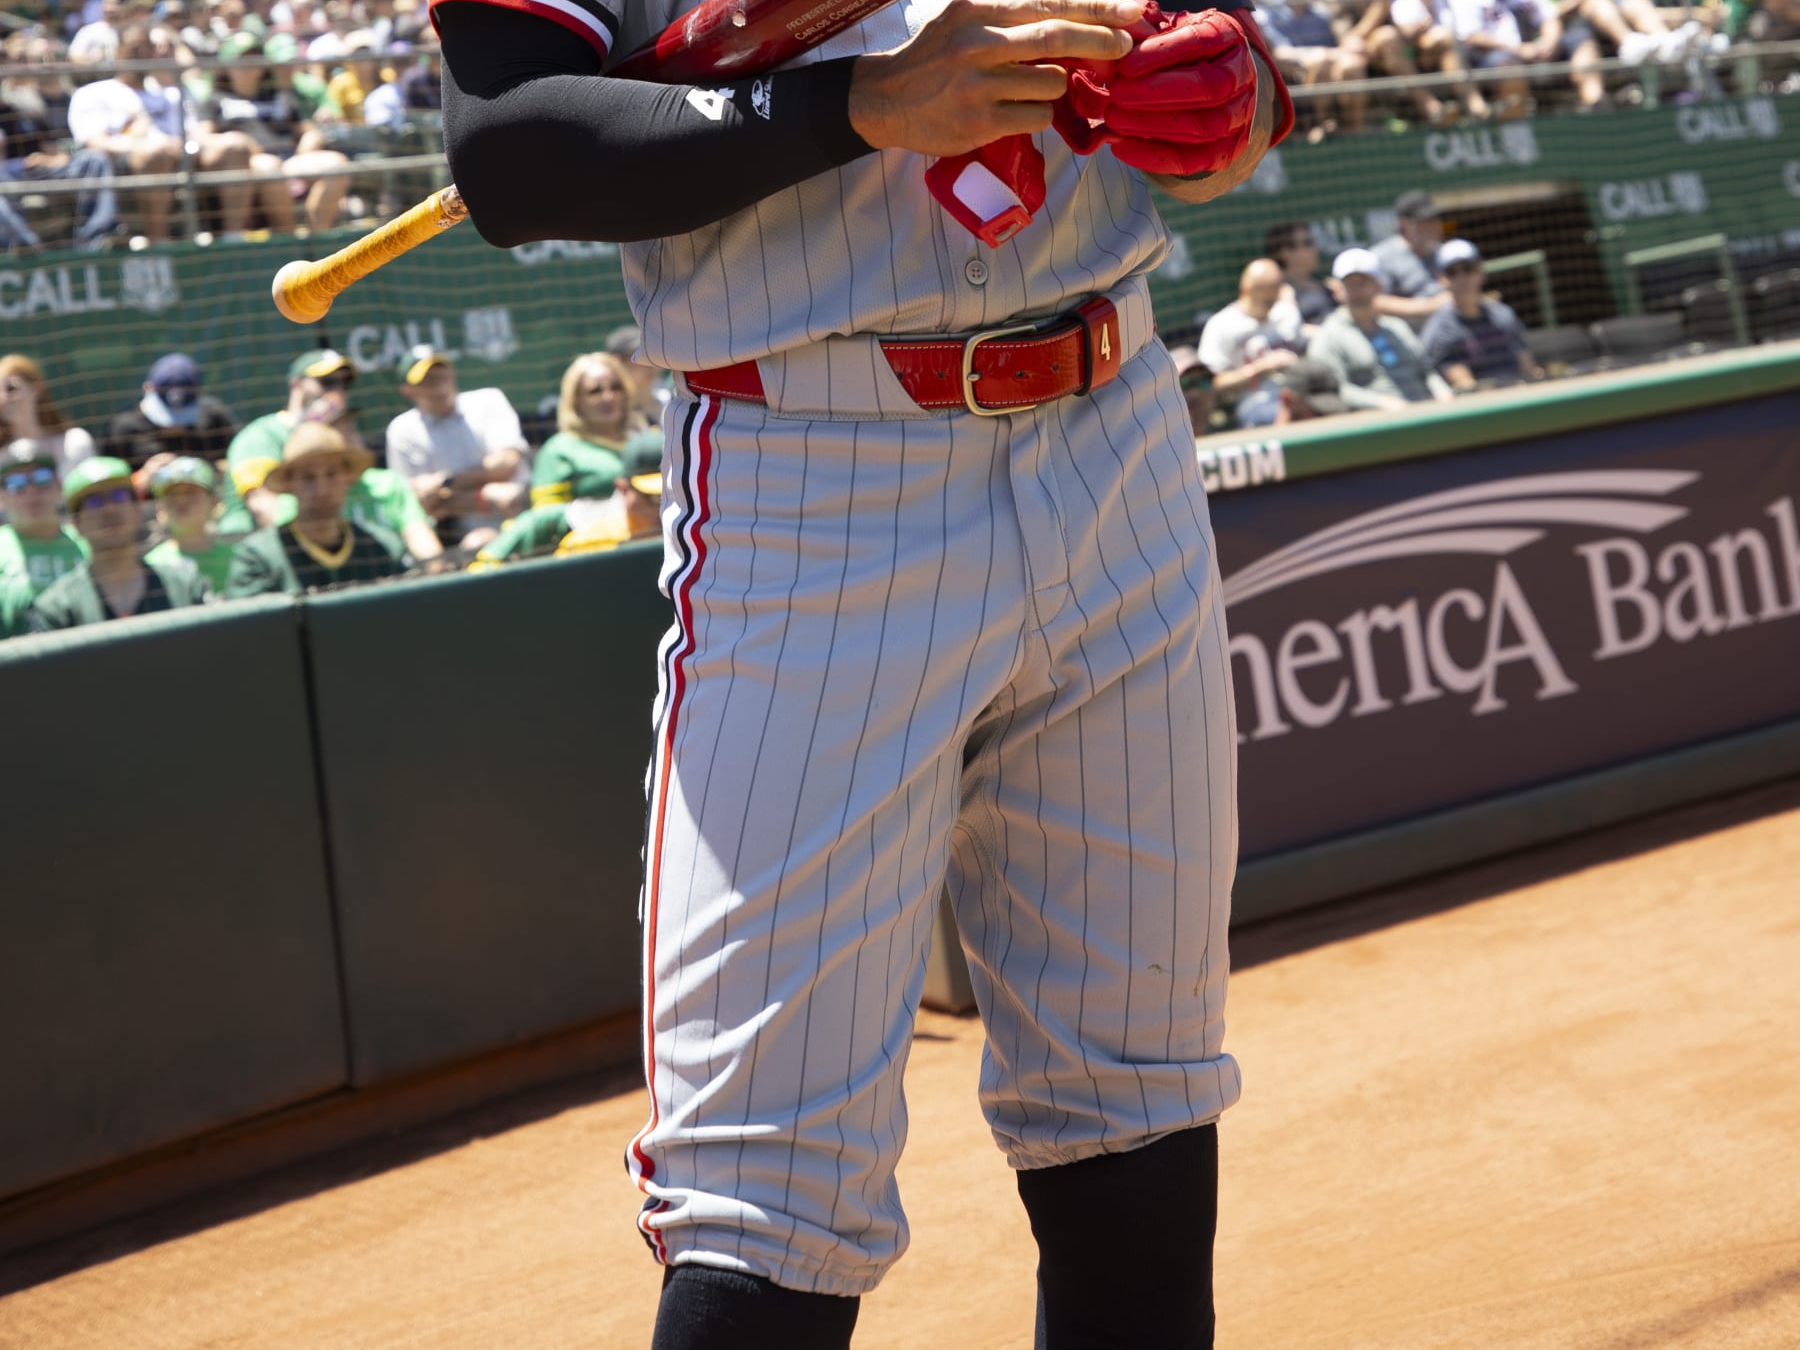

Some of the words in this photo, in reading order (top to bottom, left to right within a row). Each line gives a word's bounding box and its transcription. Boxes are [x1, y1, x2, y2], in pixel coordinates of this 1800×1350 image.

[685, 87, 735, 121] 4
[0, 264, 116, 321] CALL
[1101, 322, 1111, 361] 4
